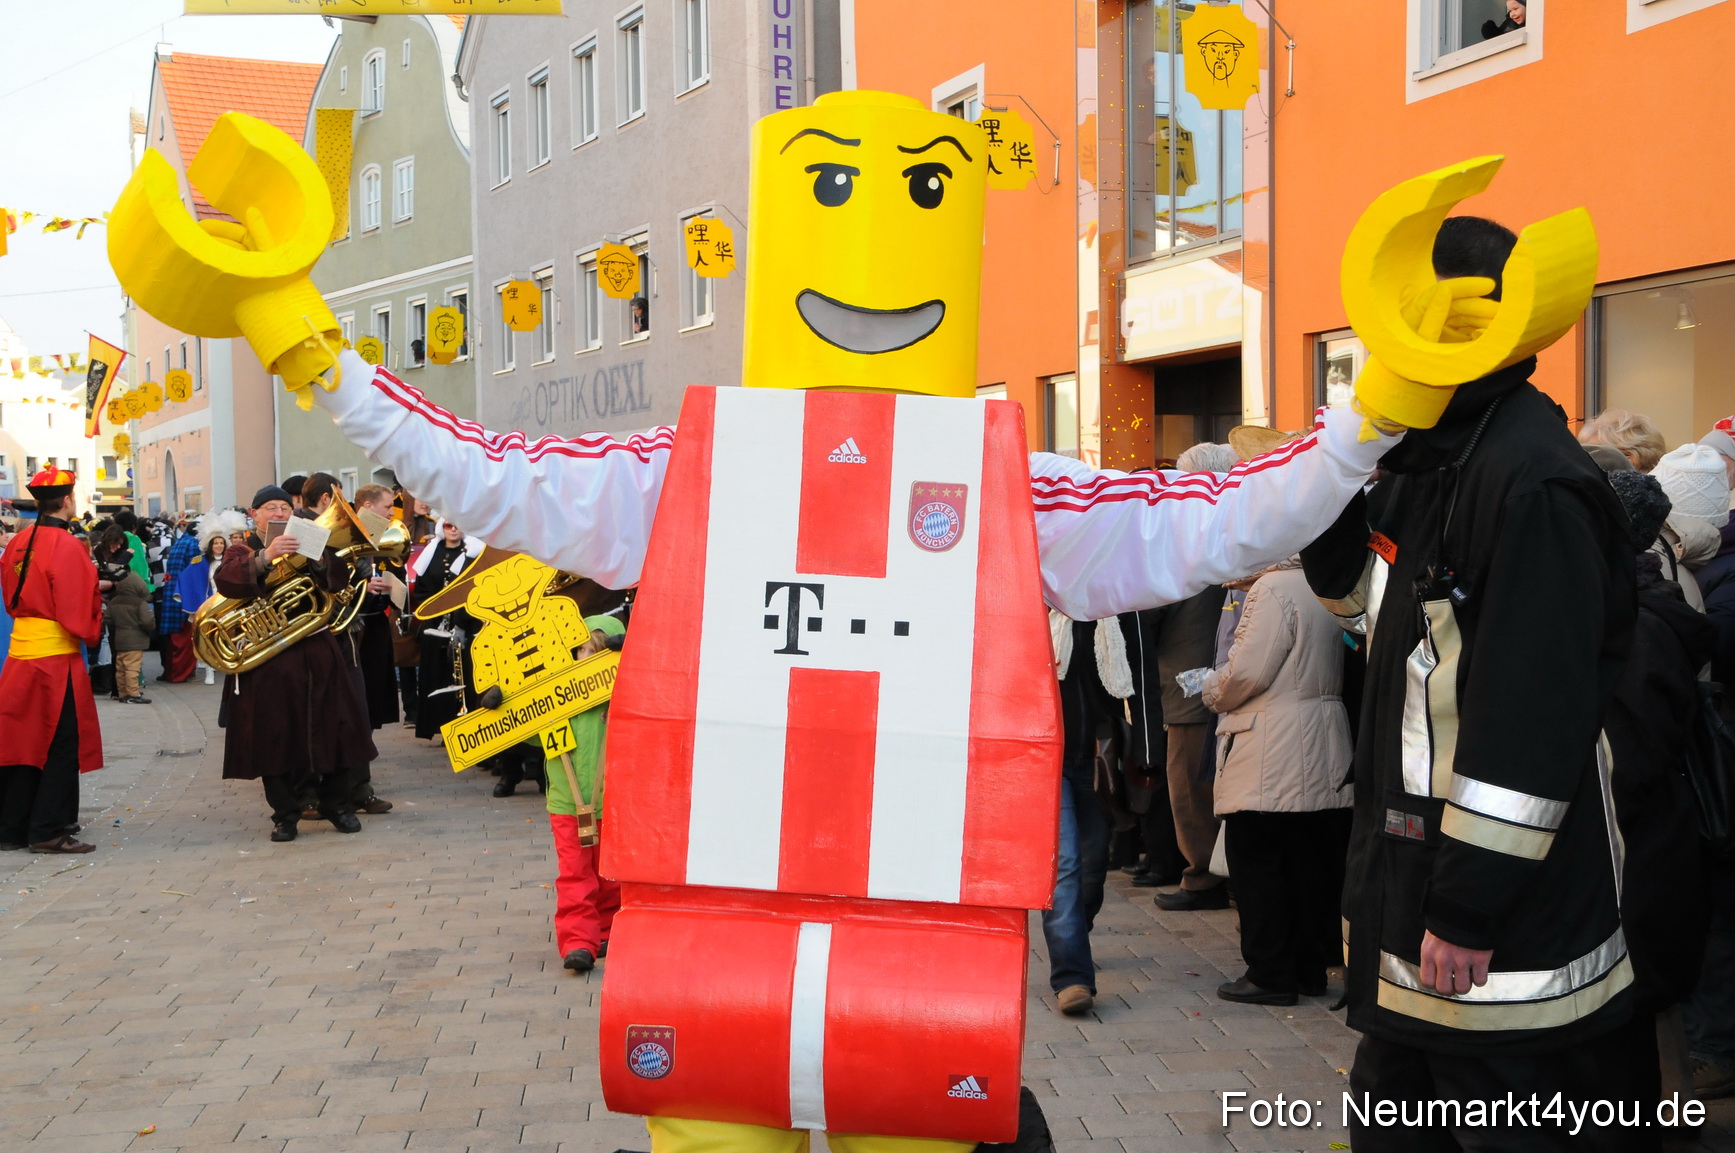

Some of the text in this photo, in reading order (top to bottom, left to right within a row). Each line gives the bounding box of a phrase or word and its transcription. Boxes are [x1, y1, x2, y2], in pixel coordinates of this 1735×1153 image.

[694, 250, 709, 268] 人
[535, 359, 652, 426] OPTIK OEXL
[828, 453, 867, 464] adidas
[916, 504, 957, 525] FC BAYERN
[457, 694, 555, 754] Dorfmusikanten
[546, 725, 568, 751] 47
[640, 1044, 668, 1061] BAYERN
[947, 1090, 987, 1100] adidas
